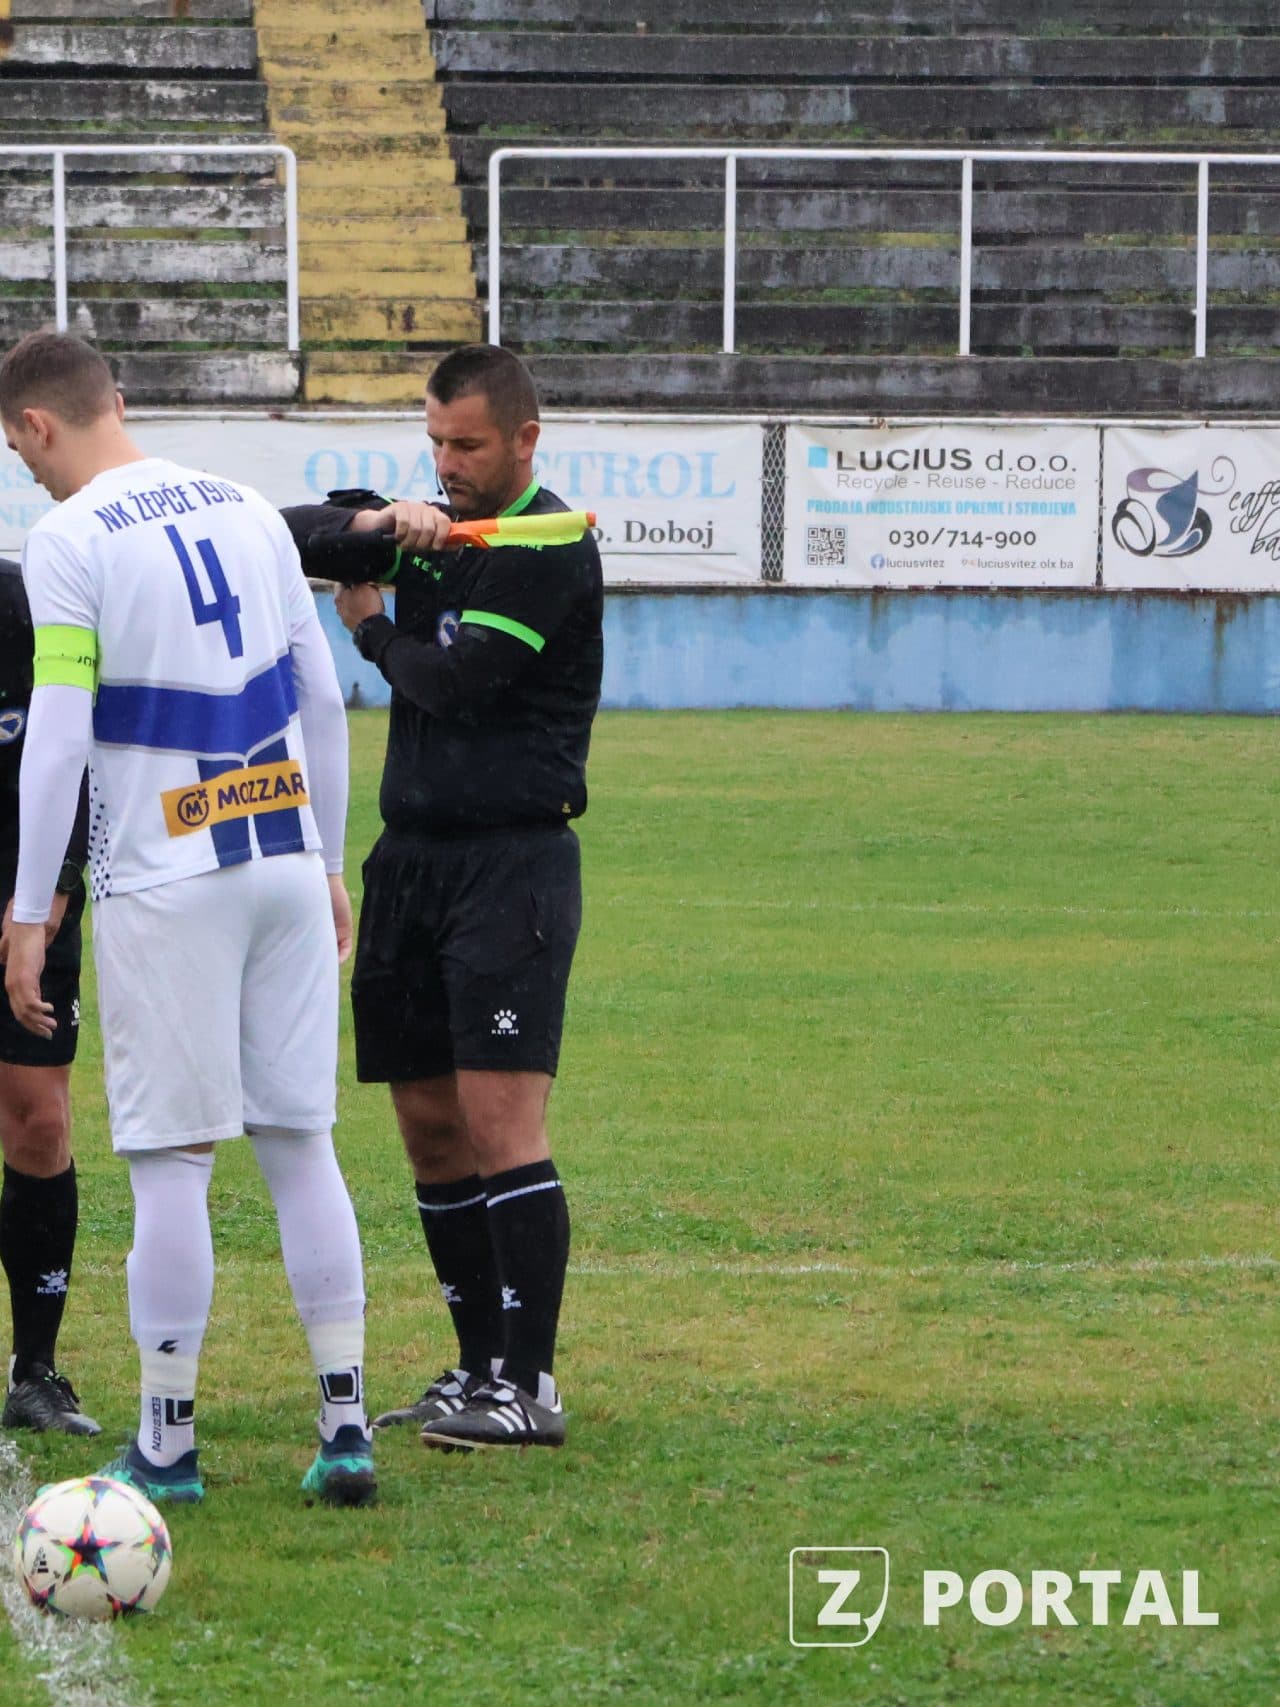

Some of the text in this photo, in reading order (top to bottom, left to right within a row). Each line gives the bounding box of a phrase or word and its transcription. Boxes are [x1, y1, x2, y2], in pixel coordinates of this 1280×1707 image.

[836, 448, 1077, 472] LUCIUS d.o.o.
[837, 473, 908, 492] Recycle
[927, 473, 986, 490] Reuse
[1006, 474, 1076, 490] Reduce
[93, 480, 244, 533] NK ŽEPČE 1919
[624, 520, 714, 548] Doboj
[889, 527, 1036, 549] 030/714-900
[886, 557, 945, 569] luciusvitez
[163, 524, 243, 659] 4
[217, 771, 306, 810] MOZZAR
